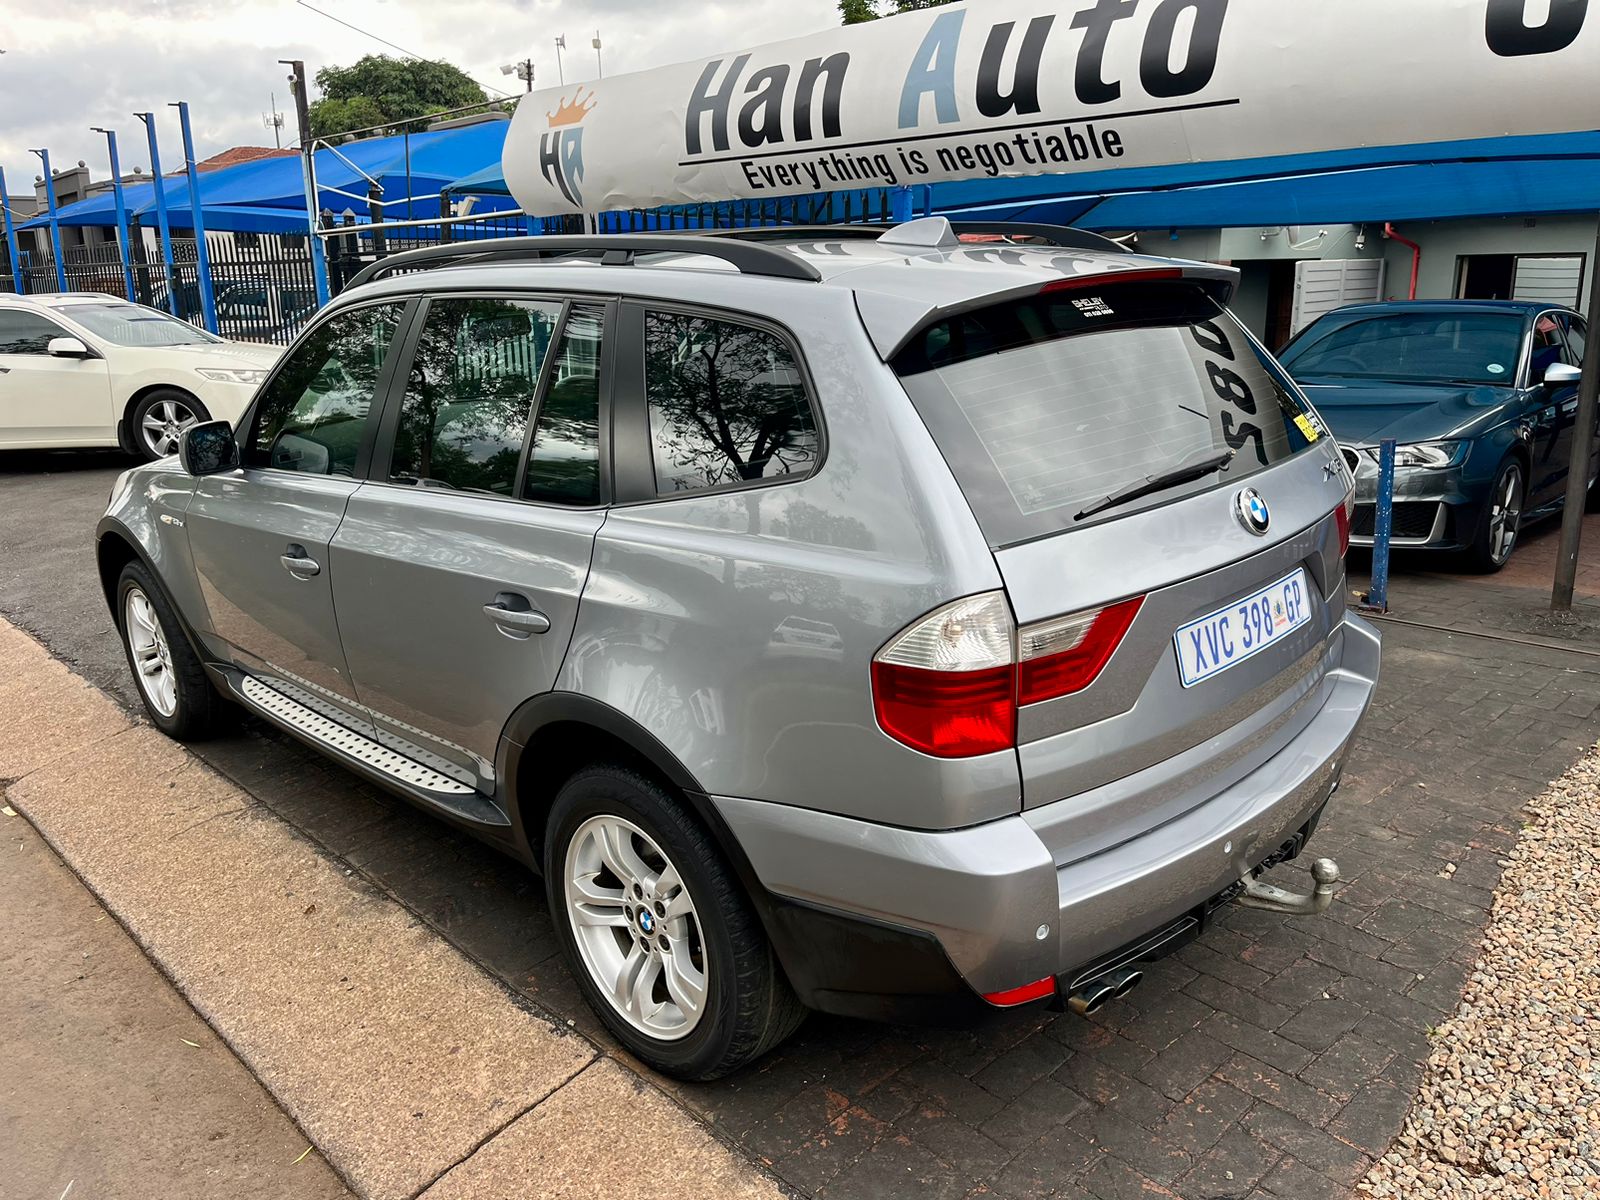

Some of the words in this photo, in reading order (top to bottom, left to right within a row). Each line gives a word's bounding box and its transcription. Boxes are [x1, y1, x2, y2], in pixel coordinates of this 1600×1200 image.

[685, 53, 850, 155] Han
[897, 0, 1229, 129] Auto
[740, 153, 898, 190] Everything
[897, 147, 930, 176] is
[935, 124, 1125, 177] negotiable
[1190, 616, 1234, 673] XVC
[1238, 596, 1274, 649] 398
[1283, 579, 1301, 624] GP
